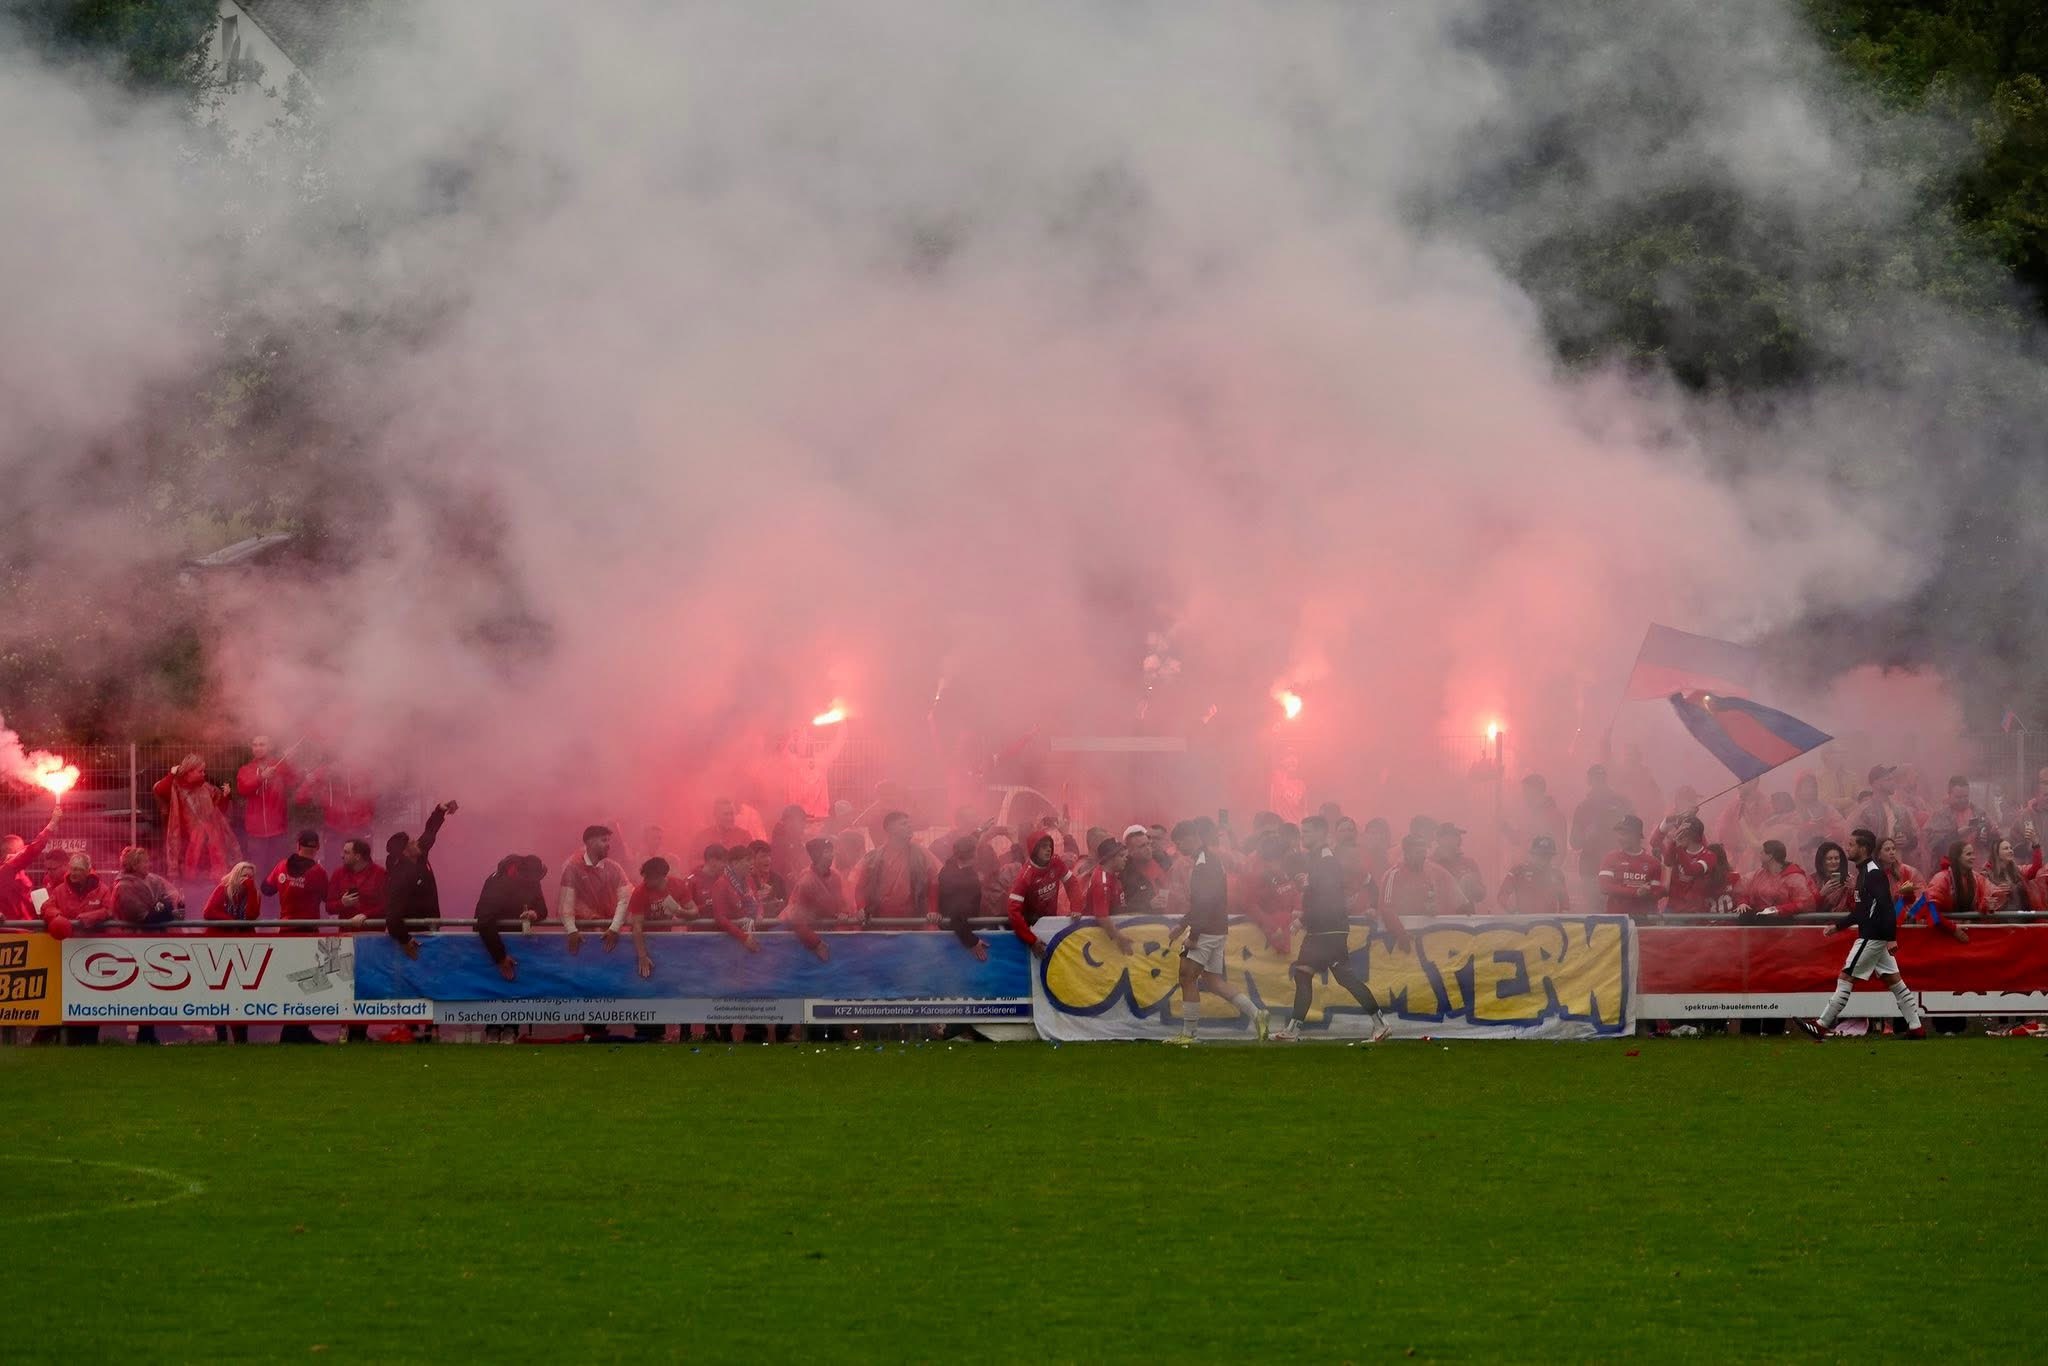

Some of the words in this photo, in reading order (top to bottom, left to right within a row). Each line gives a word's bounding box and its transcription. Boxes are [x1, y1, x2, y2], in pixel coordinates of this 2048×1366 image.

[1623, 871, 1647, 881] BECK
[69, 943, 274, 991] GSW
[68, 1003, 178, 1016] Maschinenbau
[183, 1003, 230, 1016] GmbH
[244, 1003, 278, 1016] CNC
[283, 1002, 339, 1016] Fräserei
[353, 1002, 427, 1016] Waibstadt
[835, 1007, 852, 1015] KFZ
[855, 1006, 913, 1015] Meisterbetrieb
[920, 1006, 963, 1015] Karosserie
[973, 1006, 1017, 1015] Lackiererei
[1684, 1003, 1779, 1011] spektrum-bauelemente.de
[444, 1011, 455, 1021] in
[458, 1011, 498, 1022] Sachen
[500, 1011, 561, 1021] ORDNUNG
[564, 1010, 585, 1021] und
[588, 1010, 656, 1021] SAUBERKEIT
